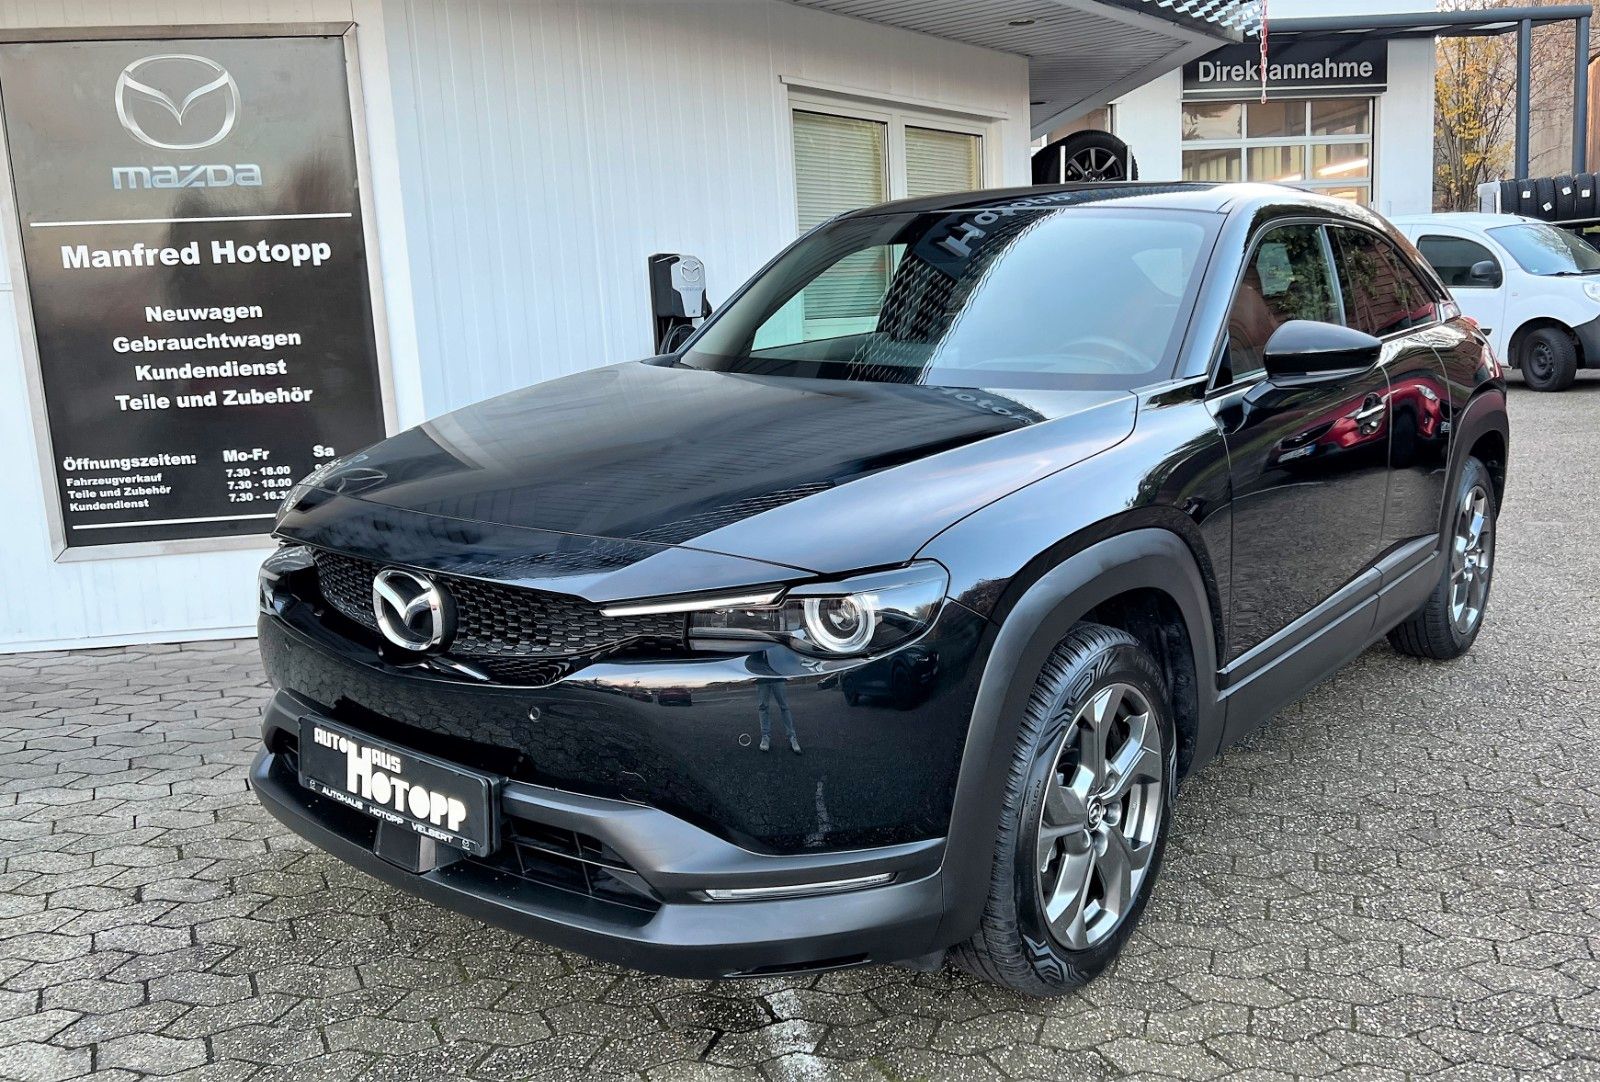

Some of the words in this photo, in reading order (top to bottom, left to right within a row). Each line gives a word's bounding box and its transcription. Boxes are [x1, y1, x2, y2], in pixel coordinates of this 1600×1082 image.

[1198, 58, 1373, 82] Direkannahme
[61, 242, 201, 269] Manfred
[210, 240, 332, 266] Hotopp
[145, 304, 264, 324] Neuwagen
[112, 331, 302, 353] Gebrauchtwagen
[135, 358, 288, 382] Kundendienst
[115, 394, 171, 411] Teile
[176, 391, 217, 408] und
[223, 386, 314, 407] Zubehör
[222, 448, 270, 463] Mo-Fr
[312, 444, 335, 458] Sa
[63, 453, 197, 471] Öffnungszeiten:
[66, 472, 162, 488] Fahrzeugverkauf
[225, 467, 251, 478] 7.30
[260, 465, 291, 476] 18.00
[67, 490, 97, 499] Teile
[100, 487, 121, 498] und
[123, 485, 172, 497] Zubehör
[227, 480, 252, 490] 7.30
[261, 477, 292, 488] 18.00
[69, 498, 150, 512] Kundendienst
[228, 492, 254, 503] 7.30
[262, 490, 290, 501] 16.3
[321, 786, 364, 810] AUTOHAUS
[368, 806, 404, 826] HOTOPP
[411, 821, 454, 844] VELBERT
